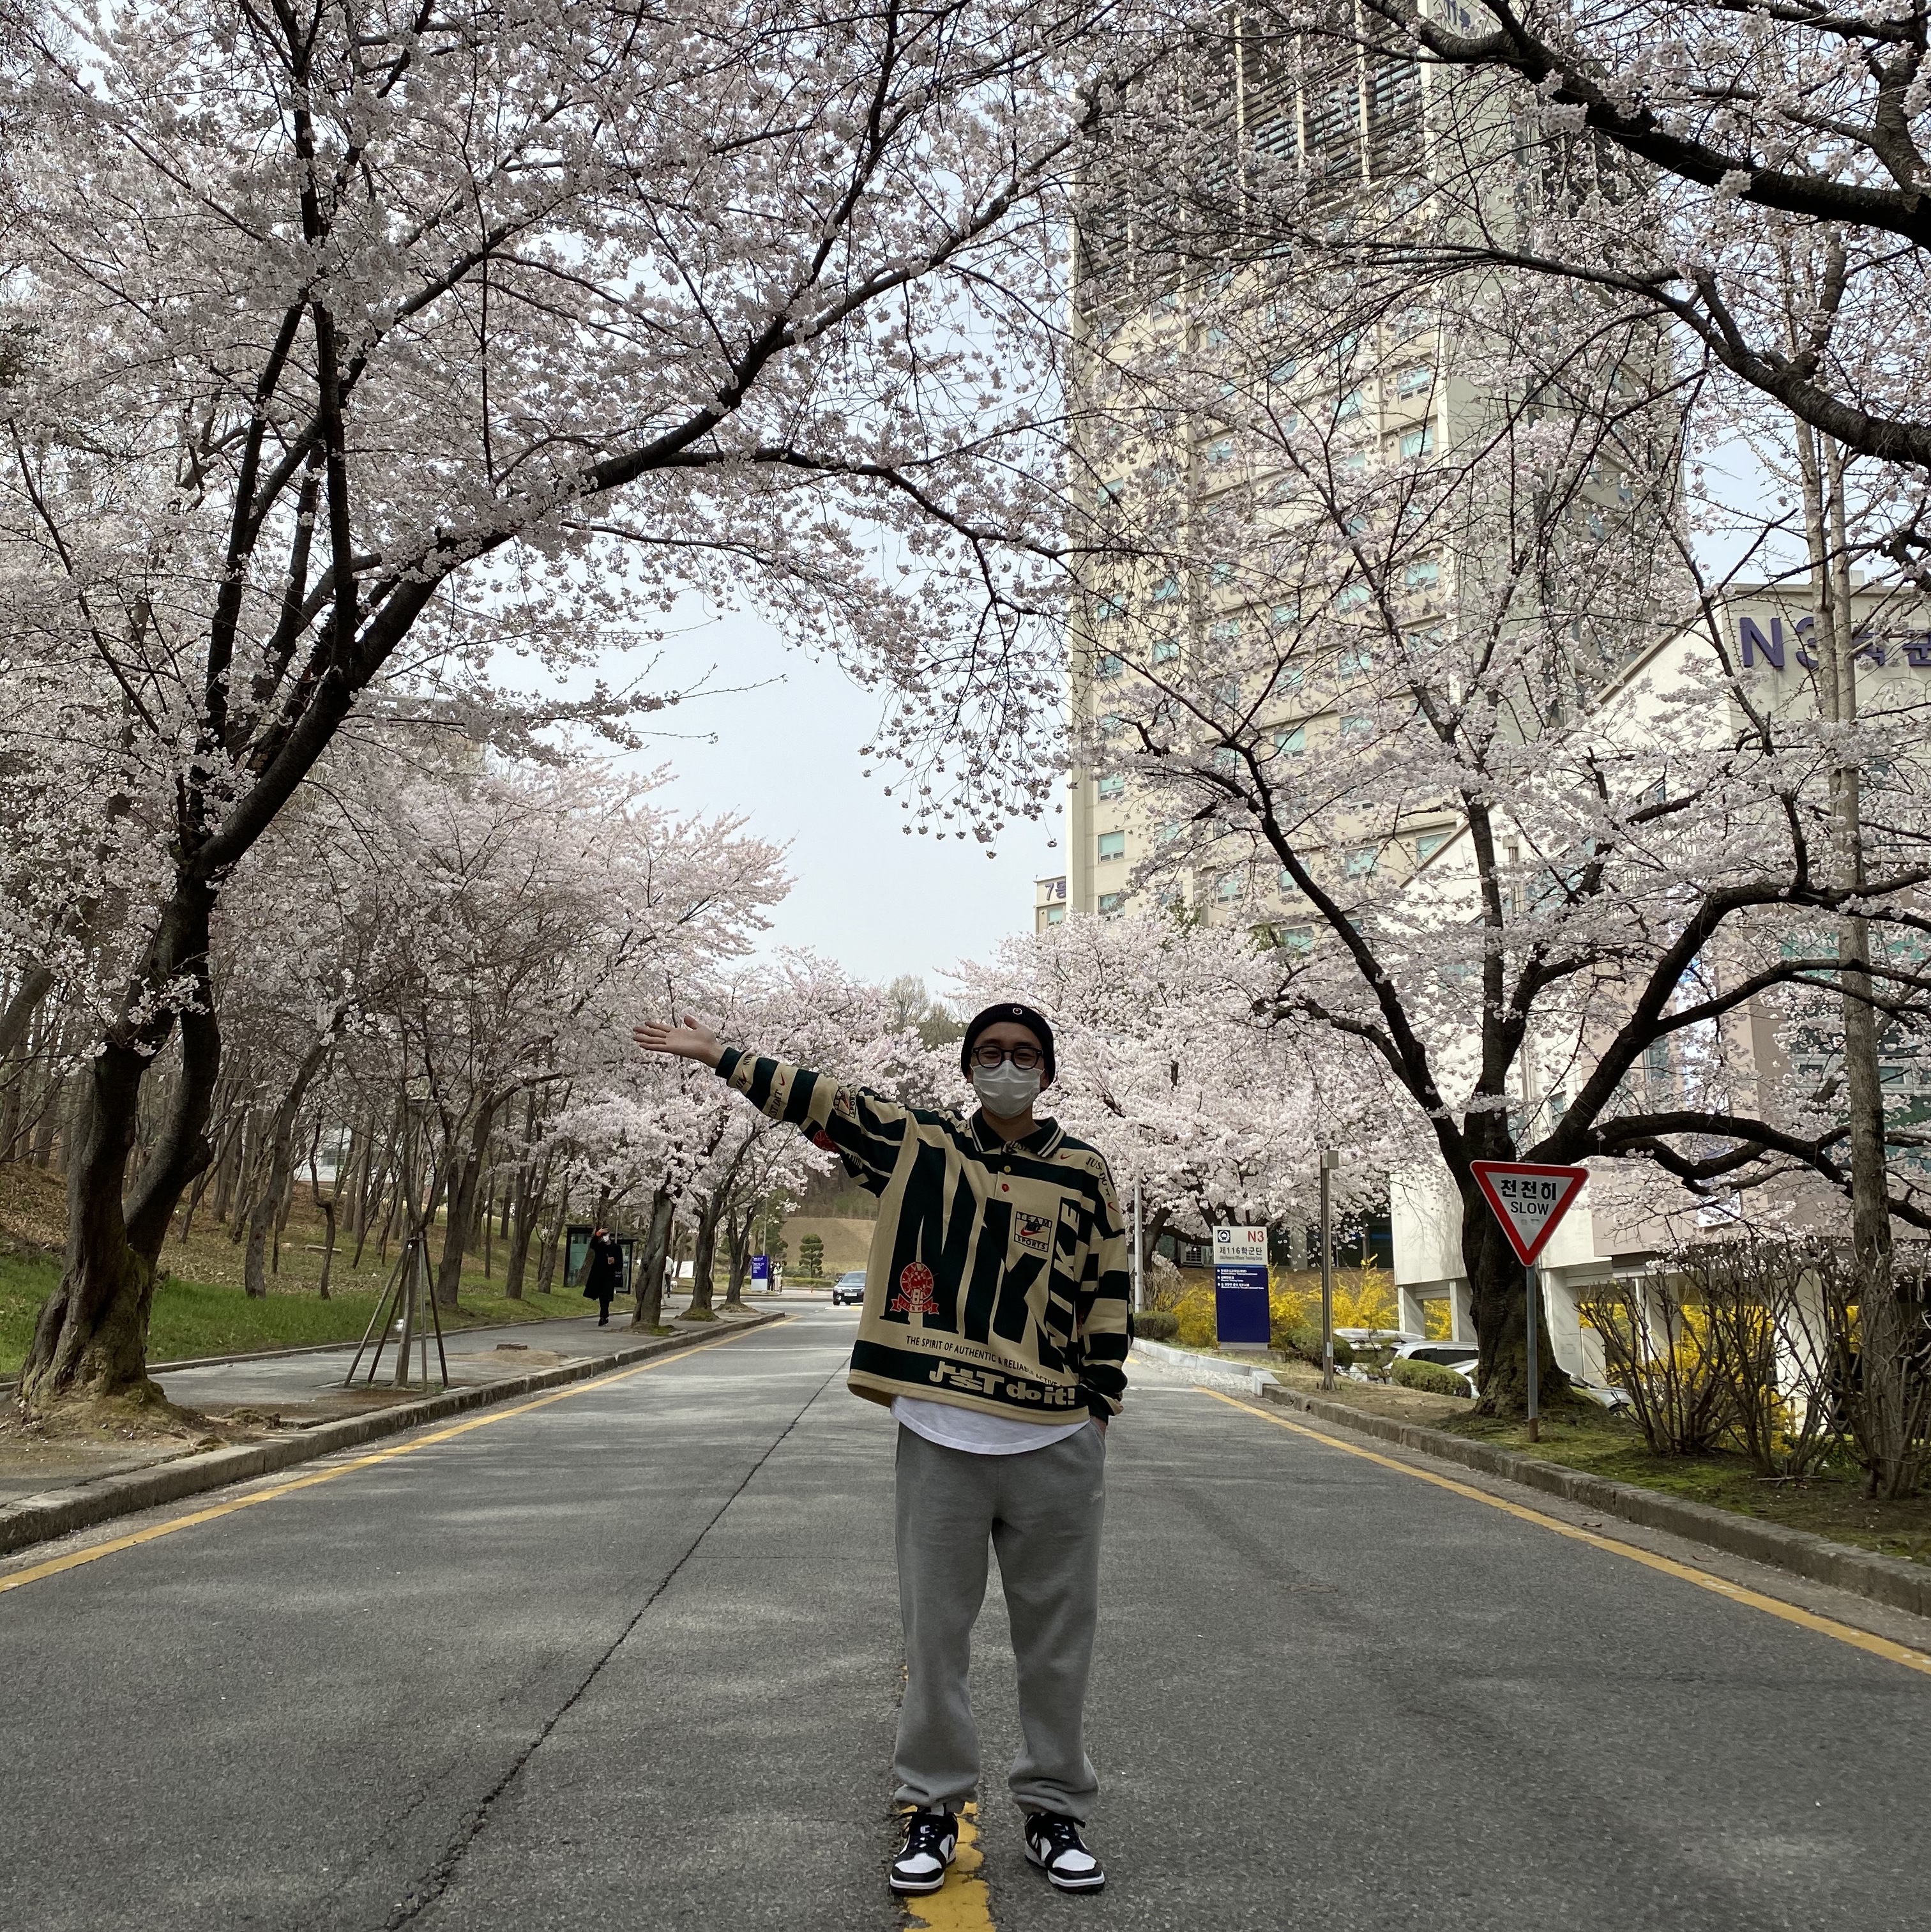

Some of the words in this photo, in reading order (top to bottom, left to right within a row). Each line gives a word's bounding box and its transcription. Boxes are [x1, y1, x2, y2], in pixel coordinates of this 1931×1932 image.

[1501, 1179, 1556, 1201] 천천히
[1510, 1201, 1549, 1215] SLOW
[1017, 1212, 1052, 1227] TEAM
[1018, 1236, 1046, 1250] SPORTS
[1248, 1230, 1264, 1242] N3
[906, 1335, 920, 1346] THE
[921, 1339, 943, 1350] SPIRIT
[944, 1343, 953, 1351] OF
[954, 1344, 996, 1362] AUTHENTIC
